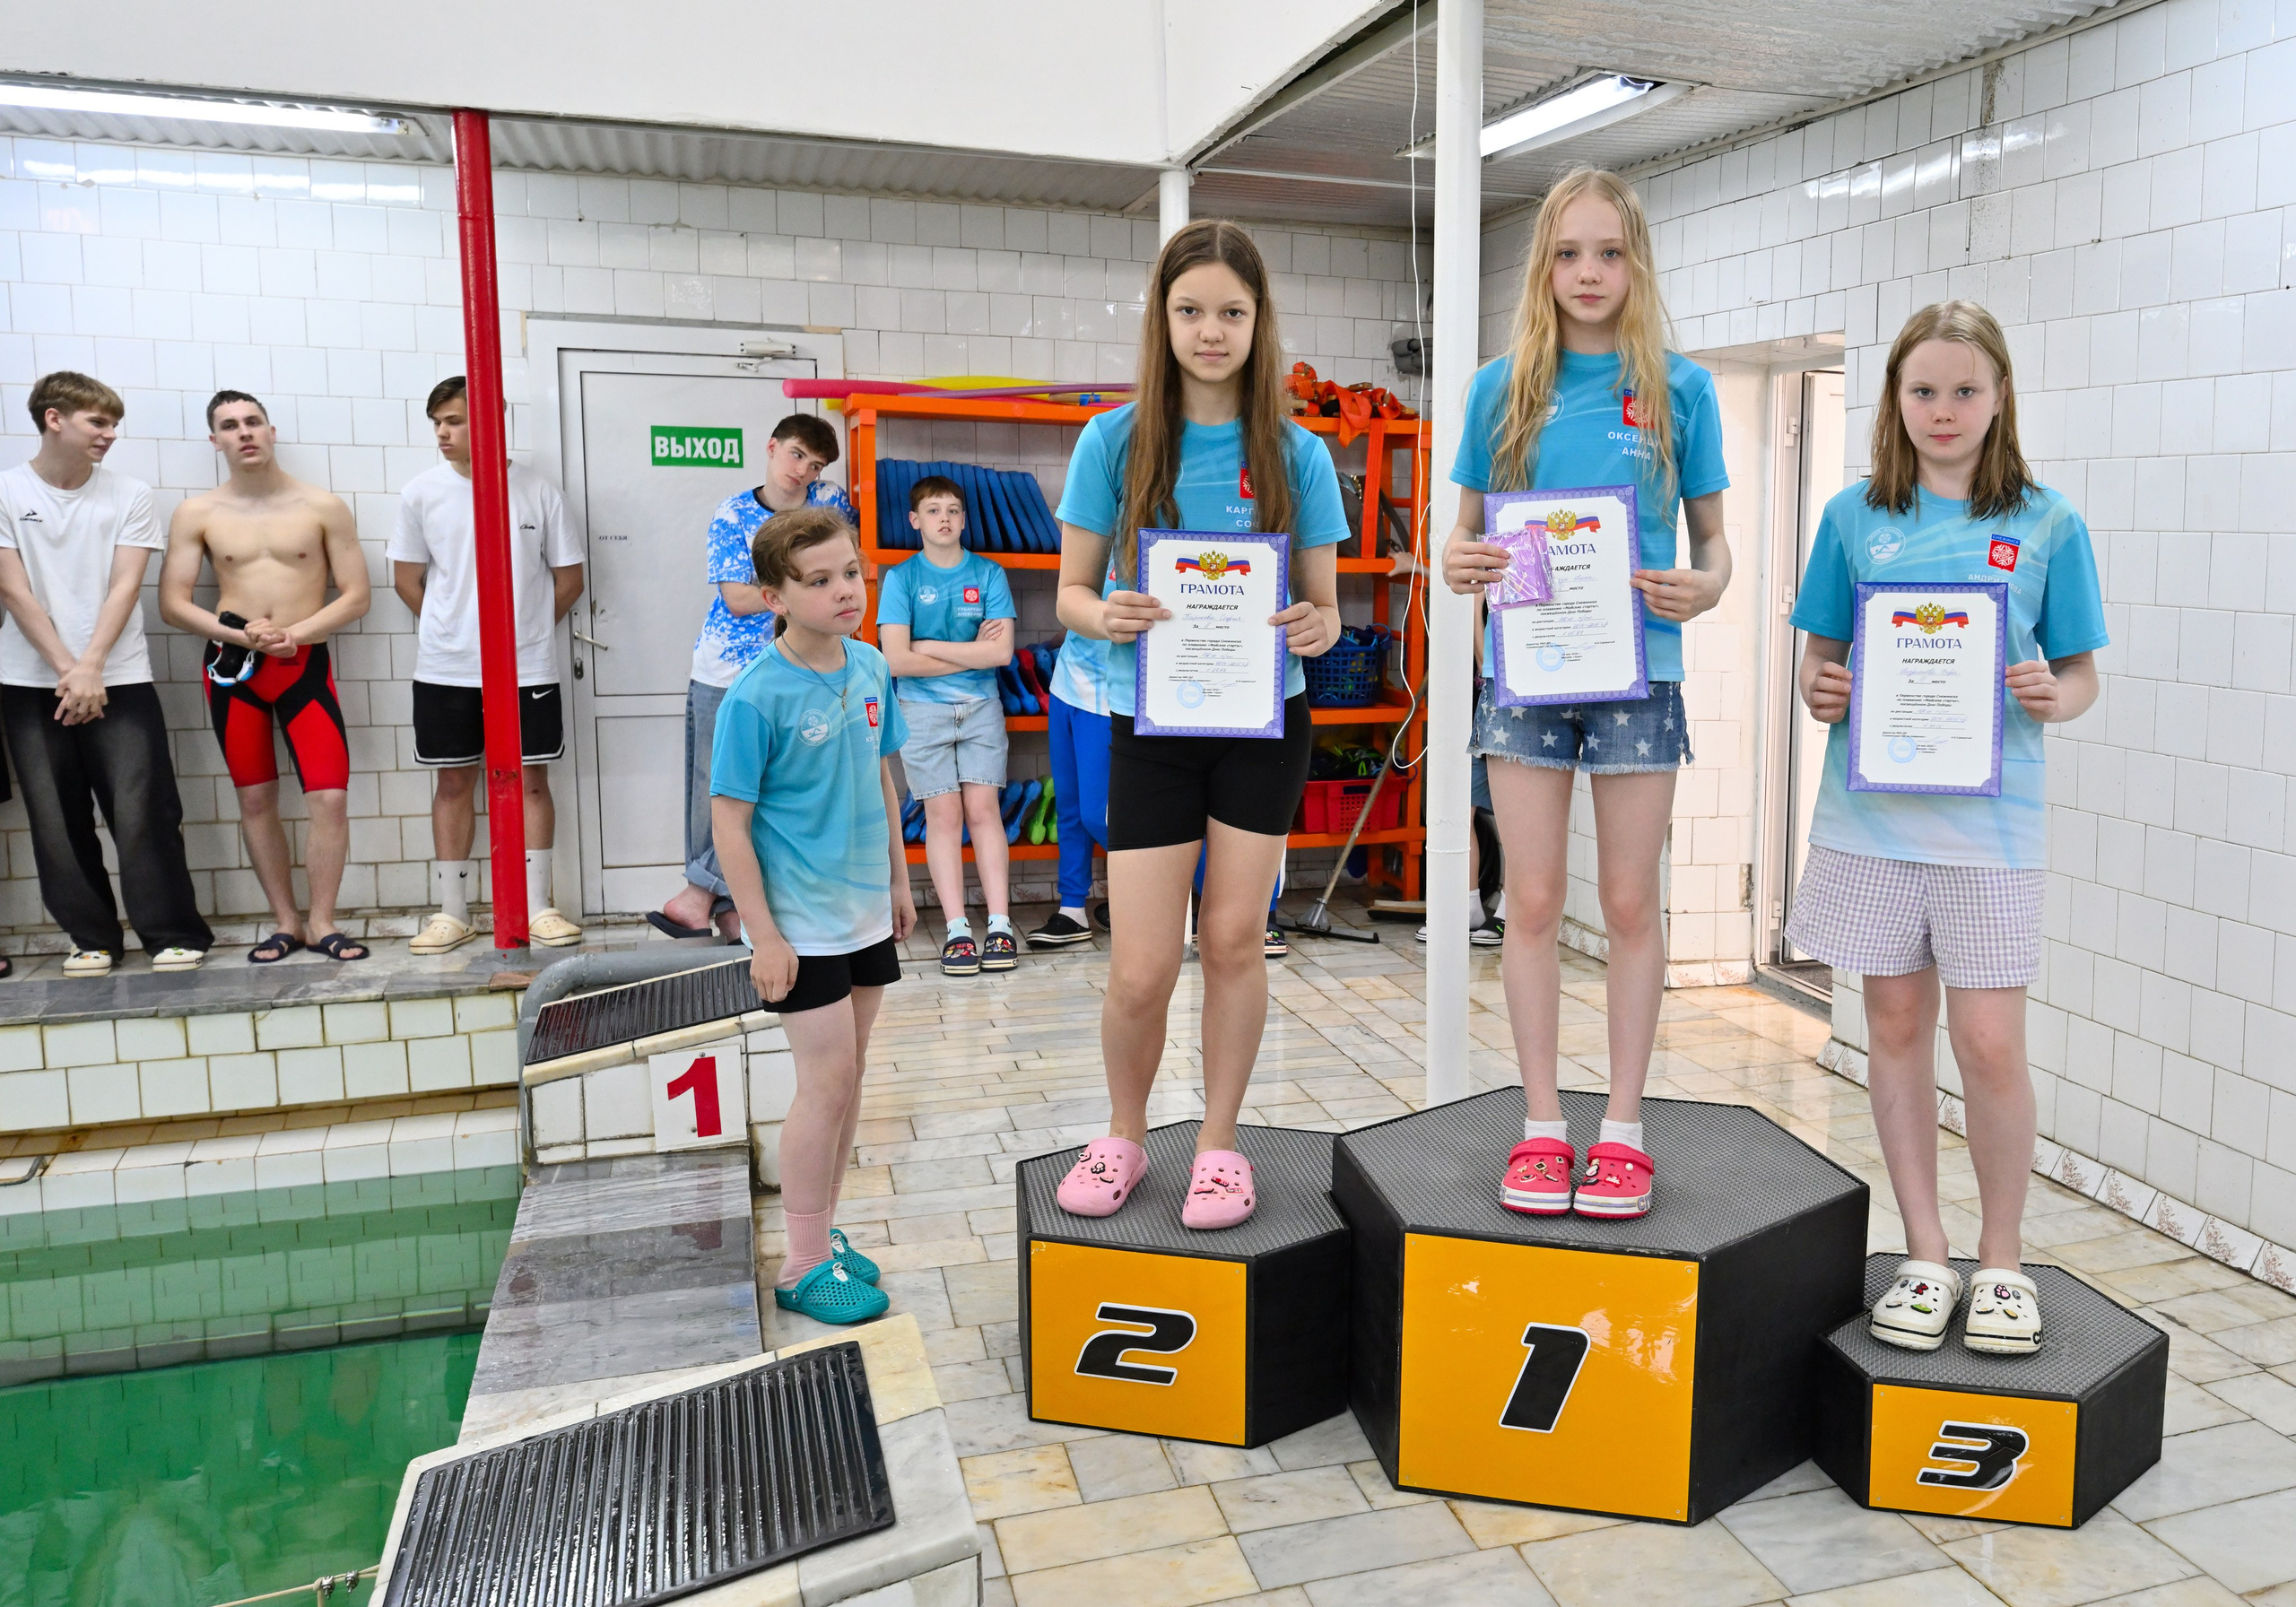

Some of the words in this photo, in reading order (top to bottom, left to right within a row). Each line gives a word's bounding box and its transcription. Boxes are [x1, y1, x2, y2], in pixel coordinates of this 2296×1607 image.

[654, 436, 740, 464] ВЫХОД
[1622, 447, 1650, 461] АННА
[1226, 505, 1255, 515] КАРП
[1548, 543, 1596, 556] АМОТА
[1180, 583, 1245, 595] ГРАМОТА
[1896, 638, 1962, 649] ГРАМОТА
[666, 1055, 723, 1138] 1
[1074, 1301, 1197, 1386] 2
[1499, 1322, 1591, 1433] 1
[1916, 1420, 2030, 1491] 3
